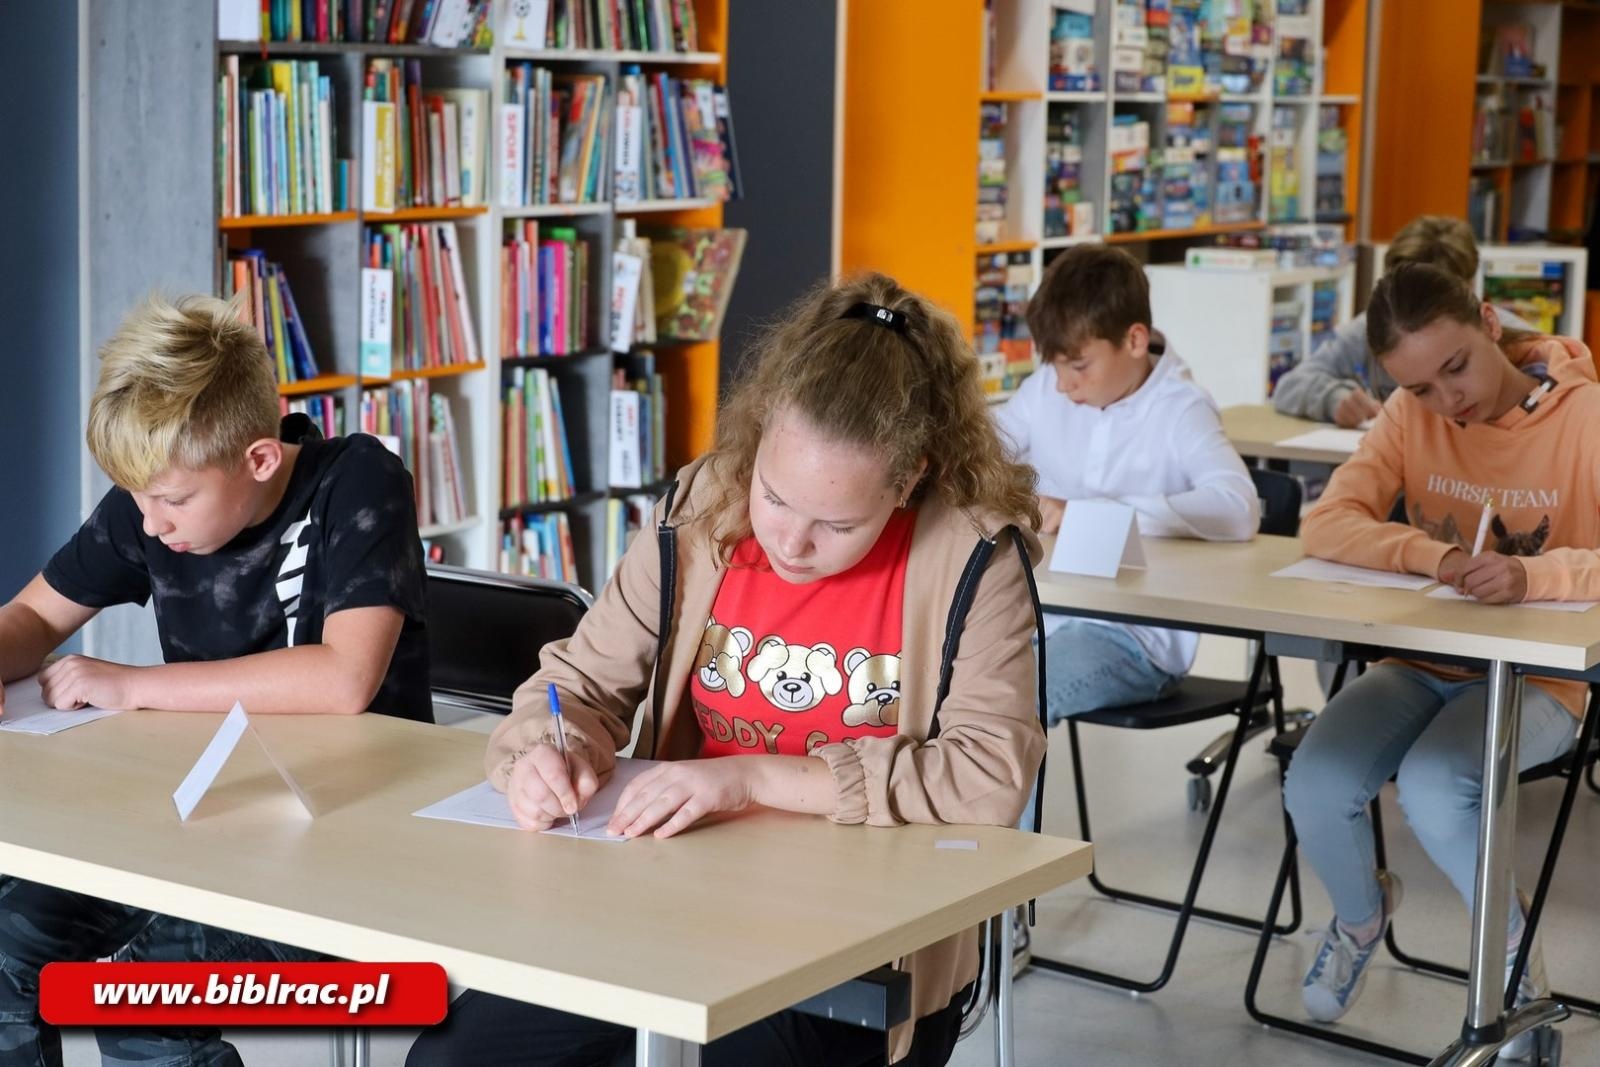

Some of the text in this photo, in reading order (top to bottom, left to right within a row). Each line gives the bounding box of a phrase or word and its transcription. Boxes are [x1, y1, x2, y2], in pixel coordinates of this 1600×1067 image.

[506, 111, 517, 170] SPORT
[1498, 487, 1558, 508] TEAM
[692, 700, 785, 755] EDDY
